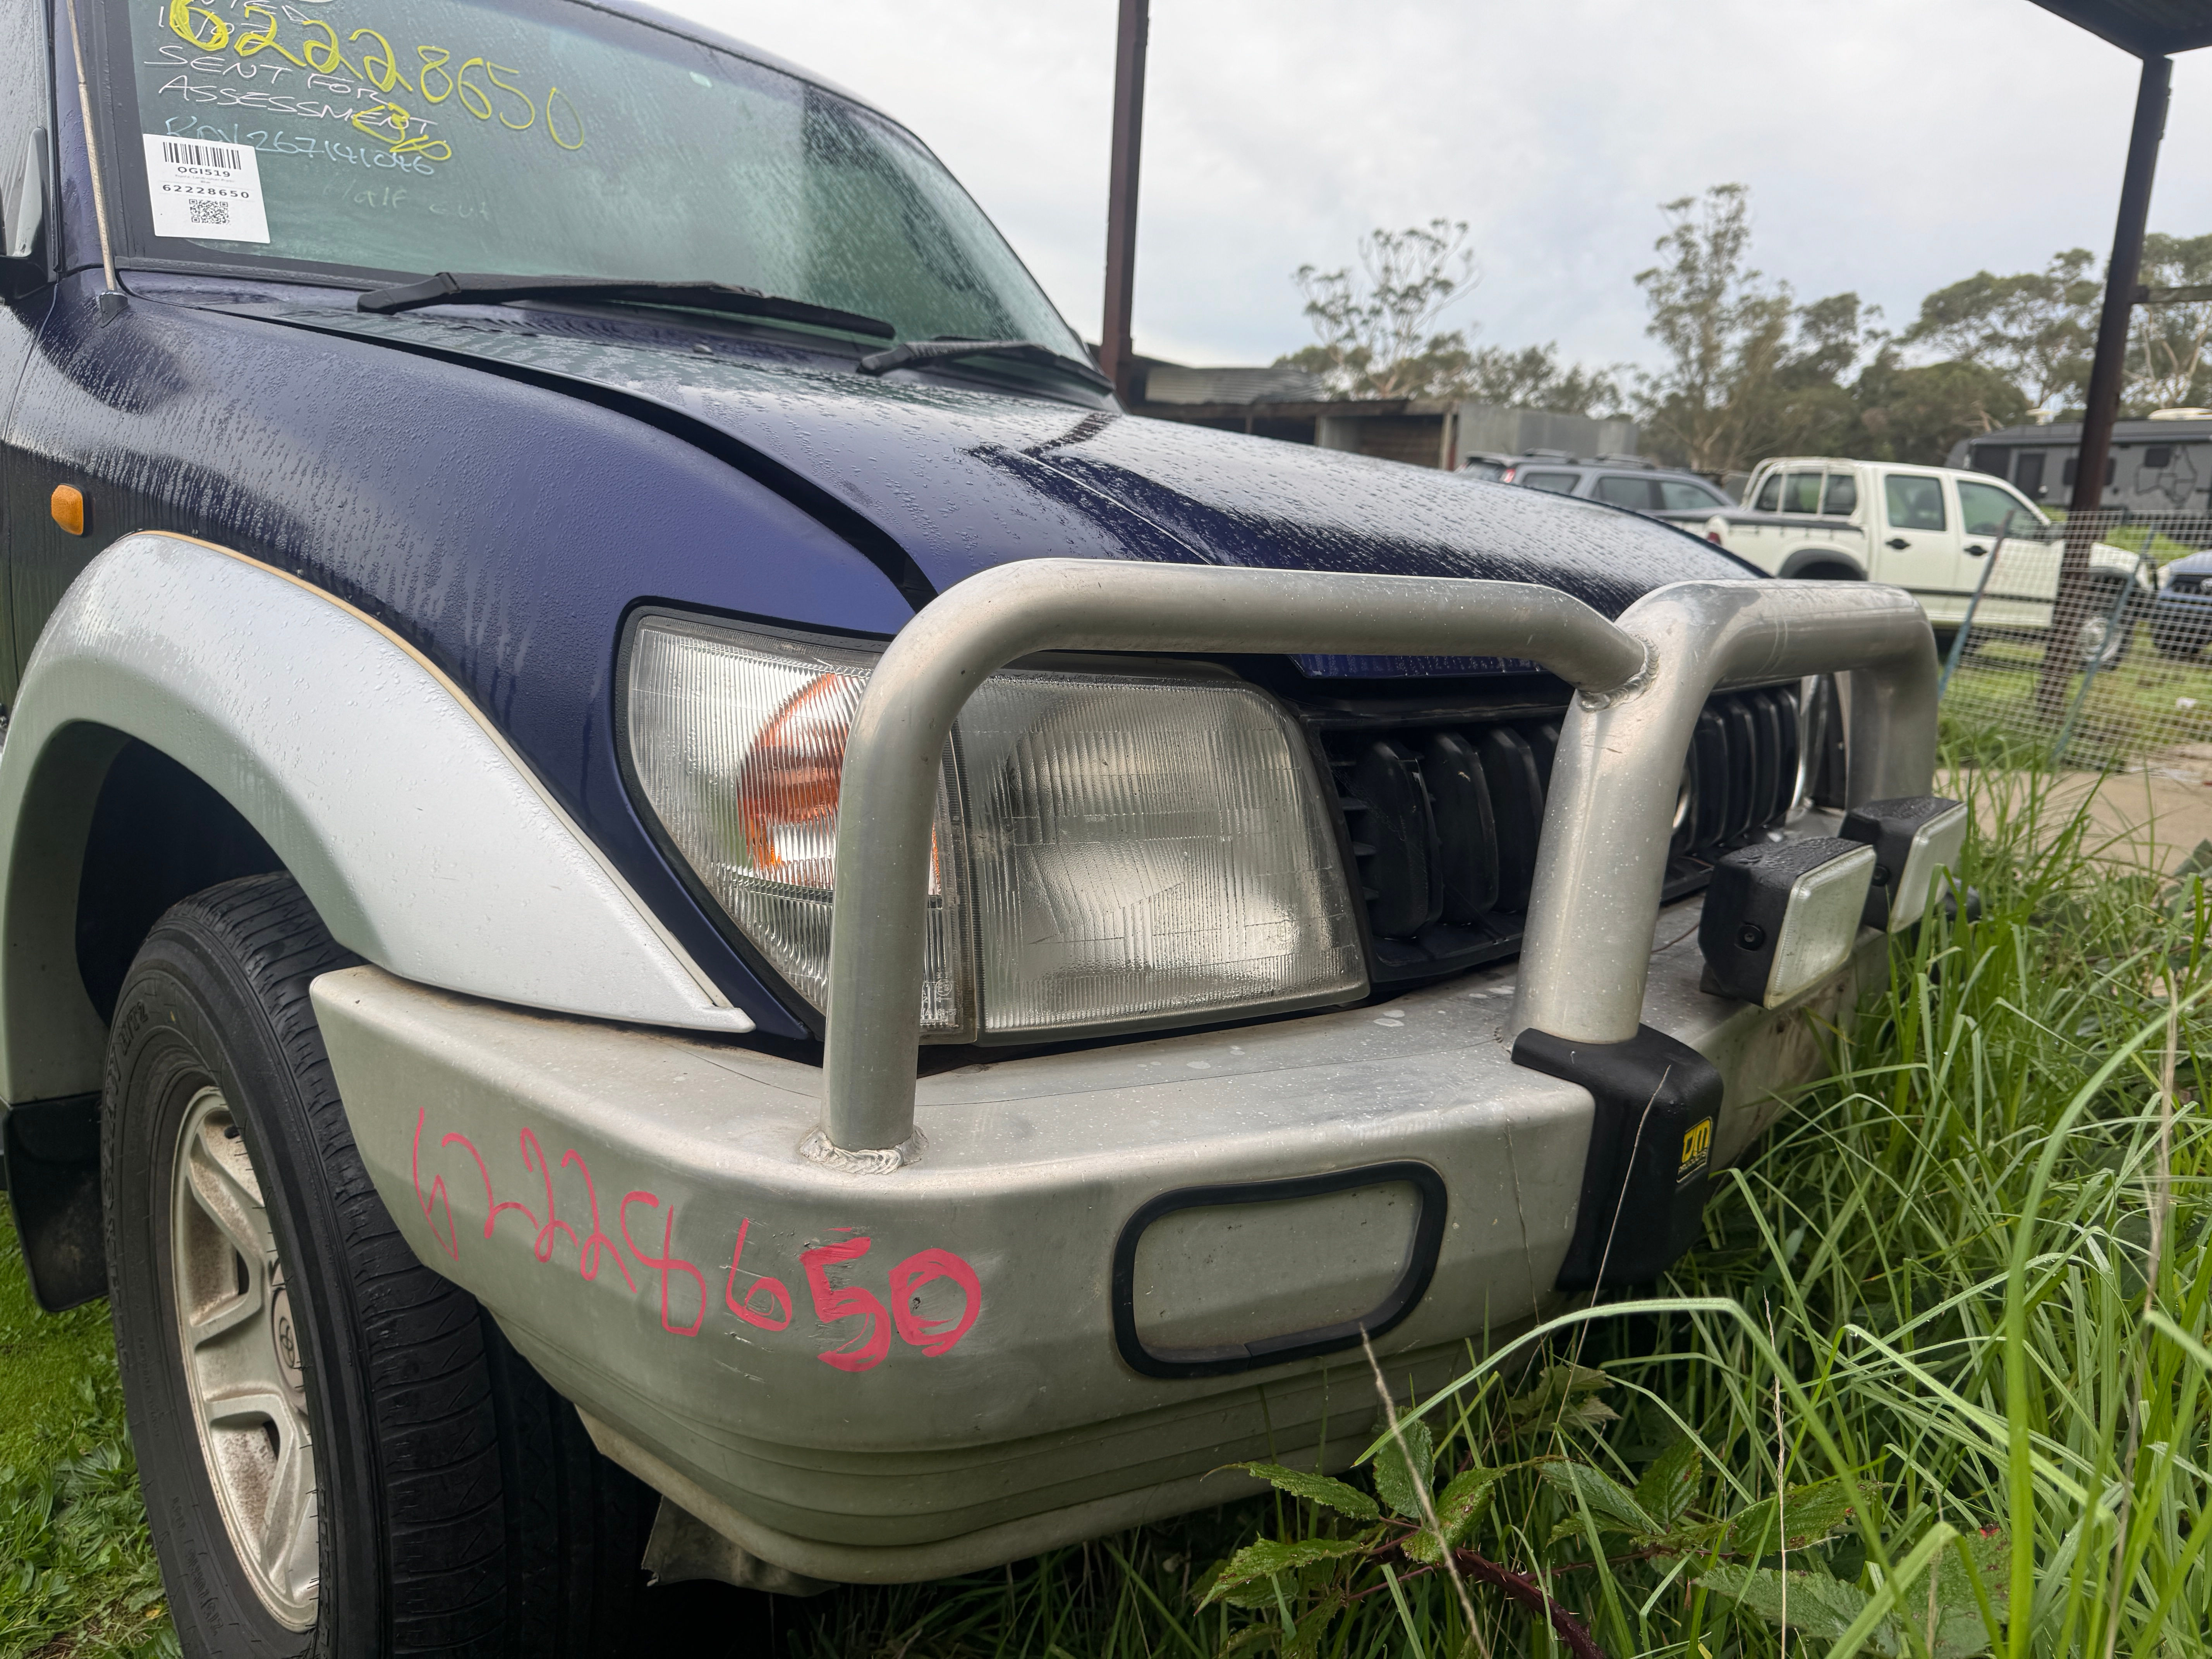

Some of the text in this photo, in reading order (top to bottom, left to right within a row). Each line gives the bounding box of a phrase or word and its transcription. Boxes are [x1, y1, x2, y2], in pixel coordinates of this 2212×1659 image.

[144, 45, 390, 106] SENT FOR
[159, 75, 438, 134] ASSESSMENT
[169, 0, 584, 149] 62228650
[162, 184, 249, 198] 62228650
[413, 1106, 982, 1373] 62228650
